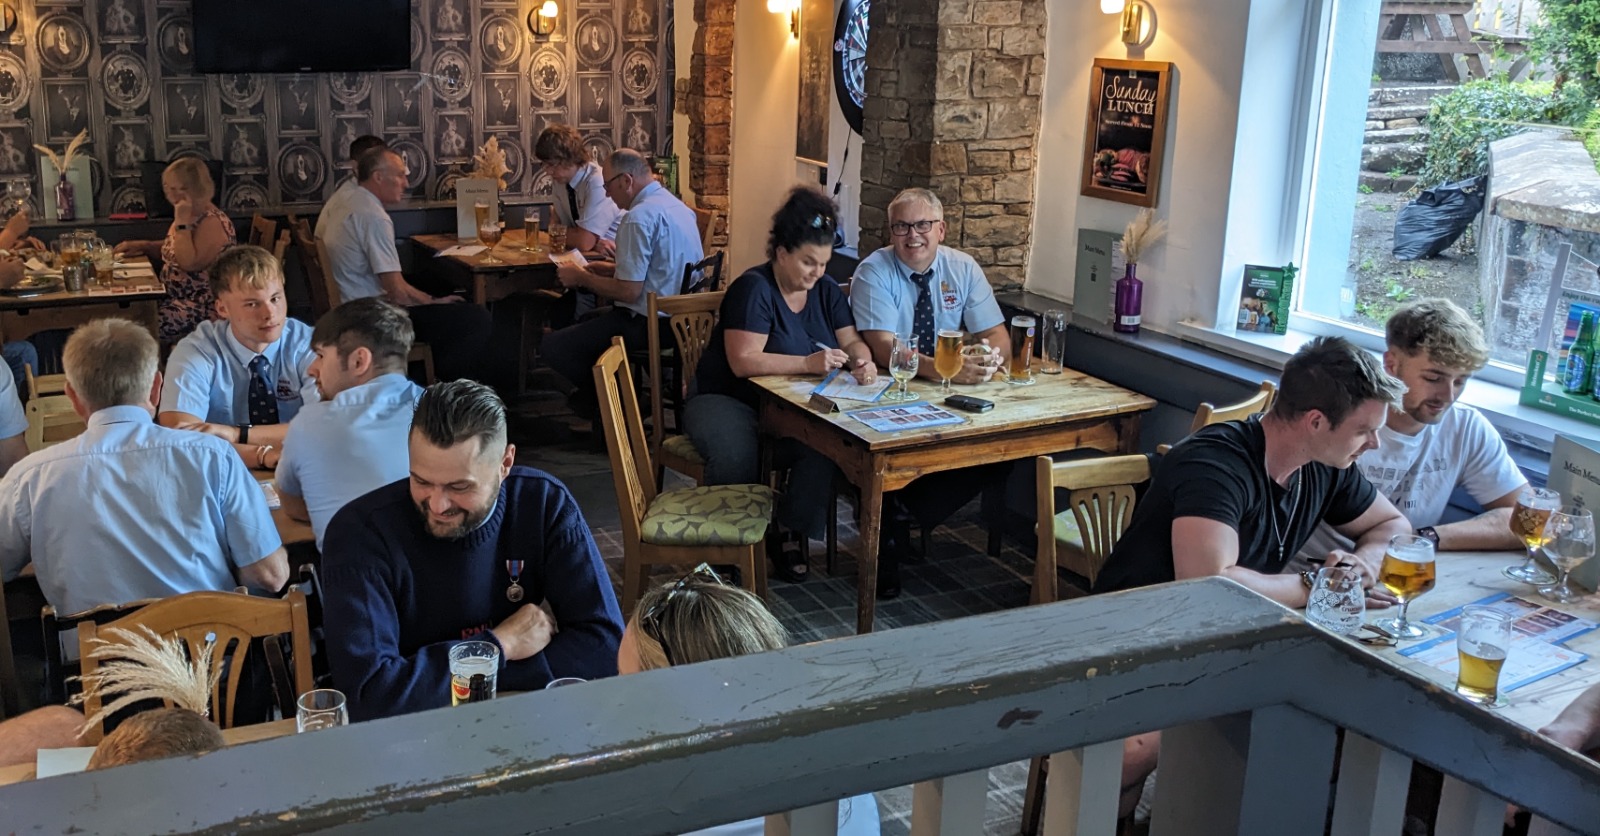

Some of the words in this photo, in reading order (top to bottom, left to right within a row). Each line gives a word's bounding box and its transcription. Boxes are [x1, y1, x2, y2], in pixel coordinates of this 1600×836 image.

[1105, 75, 1157, 105] Sunday
[1107, 99, 1154, 115] LUNCH
[1562, 290, 1579, 300] Enjoy
[1580, 294, 1590, 302] the
[1563, 460, 1582, 477] Main
